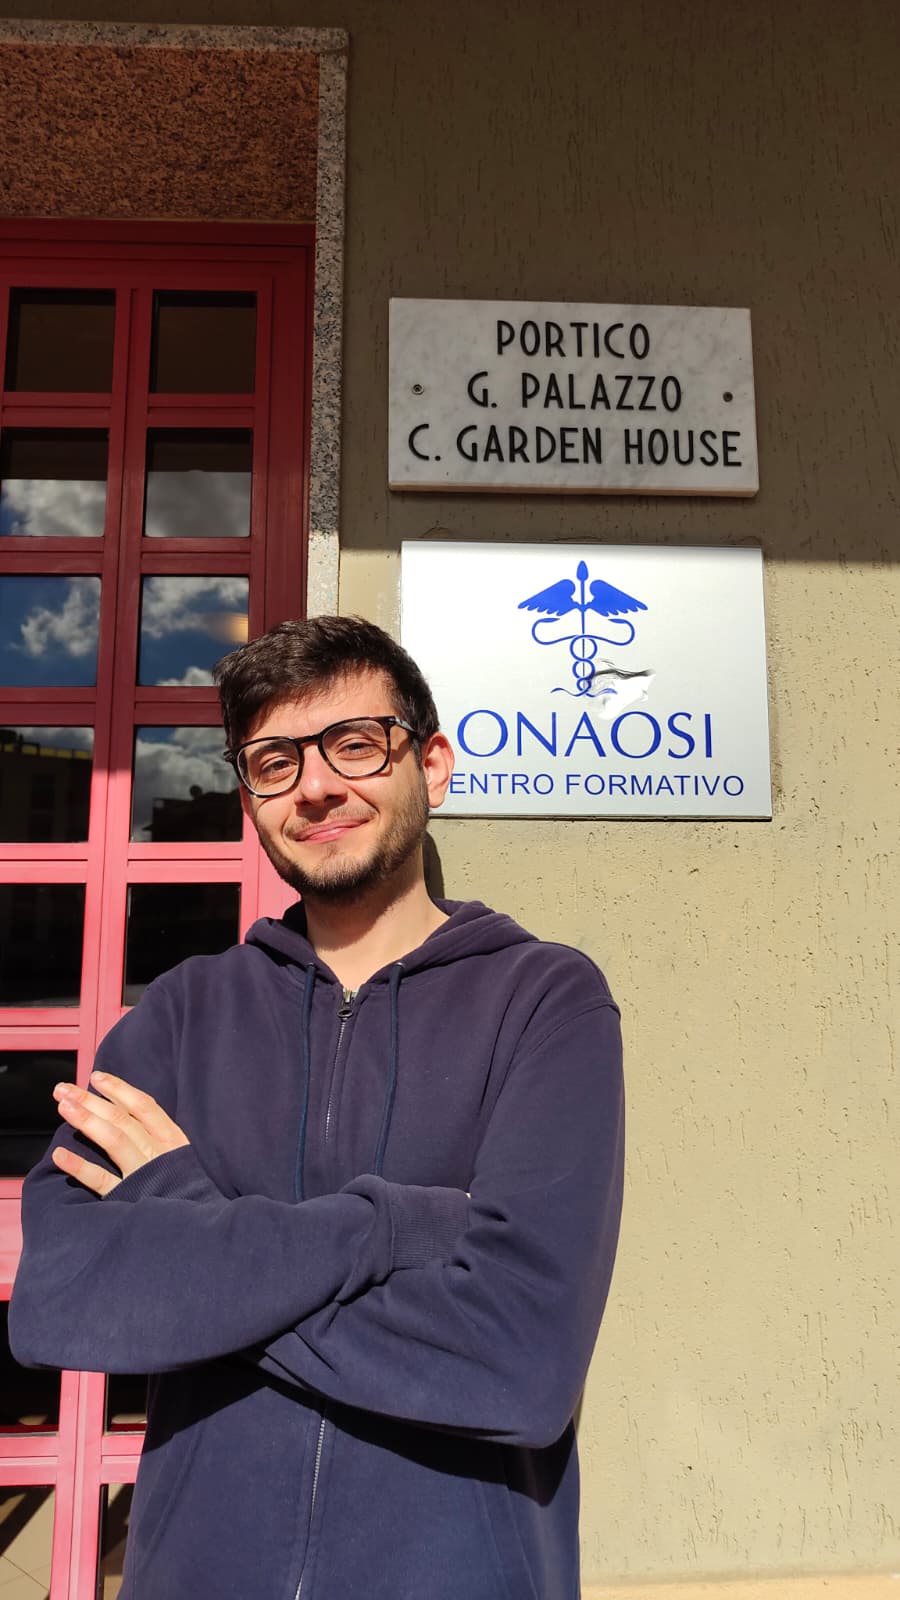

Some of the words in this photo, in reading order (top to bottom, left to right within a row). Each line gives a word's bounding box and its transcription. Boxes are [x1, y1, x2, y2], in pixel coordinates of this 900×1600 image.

[497, 320, 651, 360] PORTICO
[467, 371, 498, 409] G.
[521, 372, 682, 412] PALAZZO
[408, 423, 441, 462] C.
[456, 424, 602, 465] GARDEN
[624, 428, 743, 467] HOUSE
[457, 709, 713, 759] ONAOSI
[449, 772, 555, 796] ENTRO
[565, 773, 745, 797] FORMATIVO
